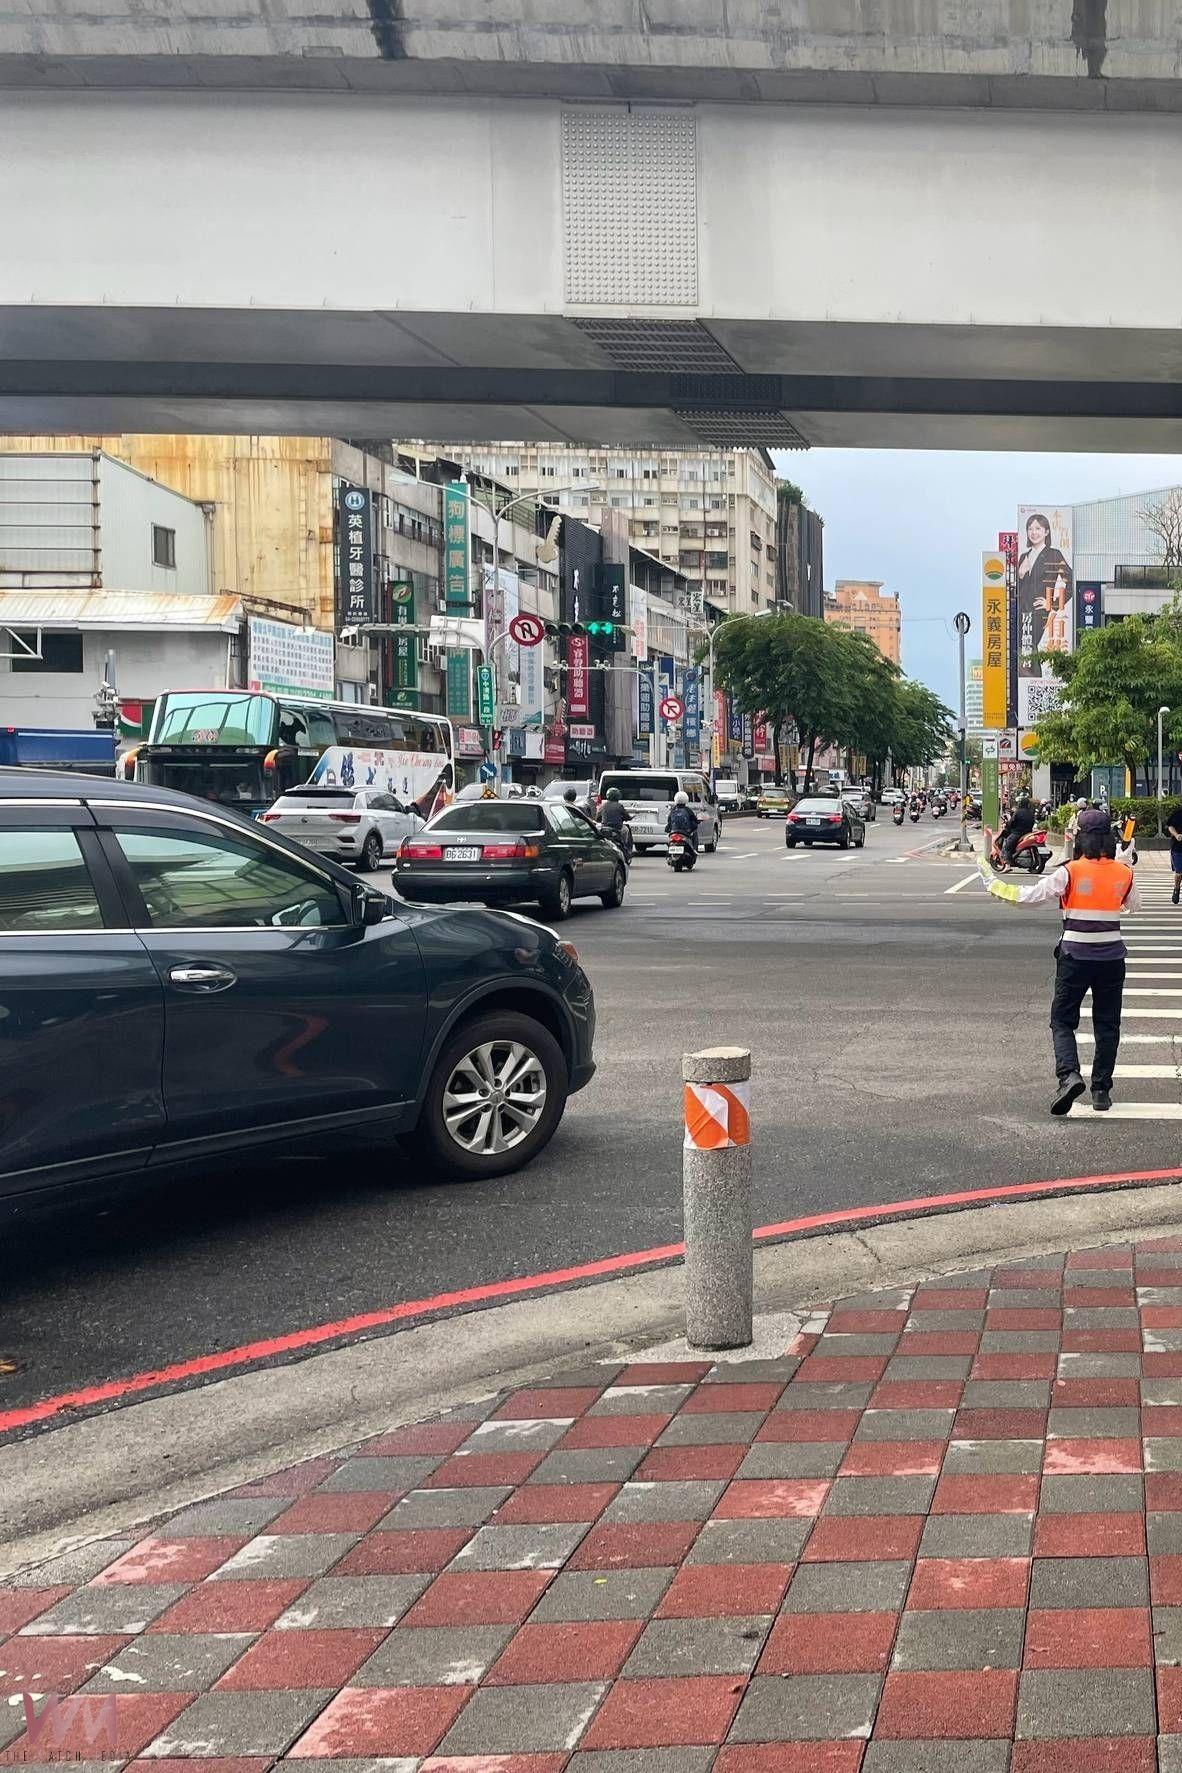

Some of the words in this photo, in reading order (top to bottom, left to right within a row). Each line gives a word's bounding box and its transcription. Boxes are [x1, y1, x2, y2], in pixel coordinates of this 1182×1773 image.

[348, 514, 365, 609] 英植牙醫診所
[987, 599, 1002, 668] 永義房屋
